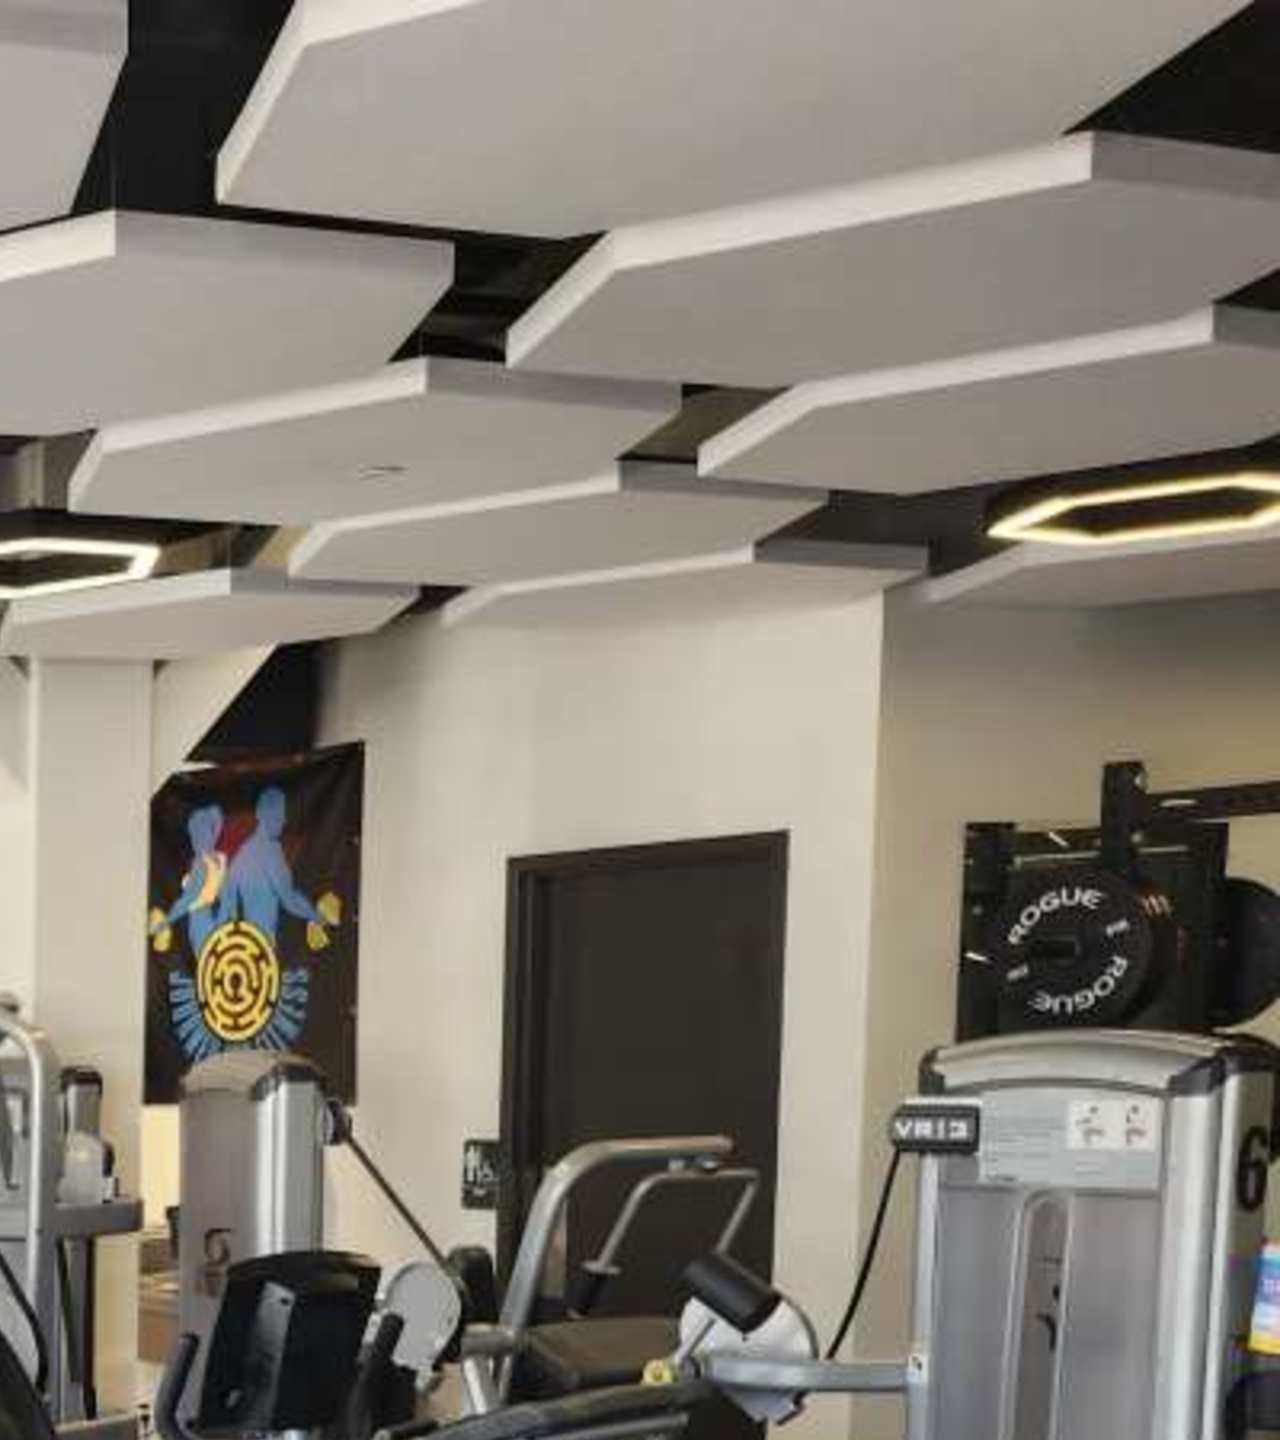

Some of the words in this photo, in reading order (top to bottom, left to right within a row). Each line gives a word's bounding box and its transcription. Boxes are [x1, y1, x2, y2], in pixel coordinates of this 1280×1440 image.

[1007, 886, 1104, 945] ROGUE
[1028, 955, 1129, 1016] ROGUE
[1235, 1125, 1270, 1212] 6
